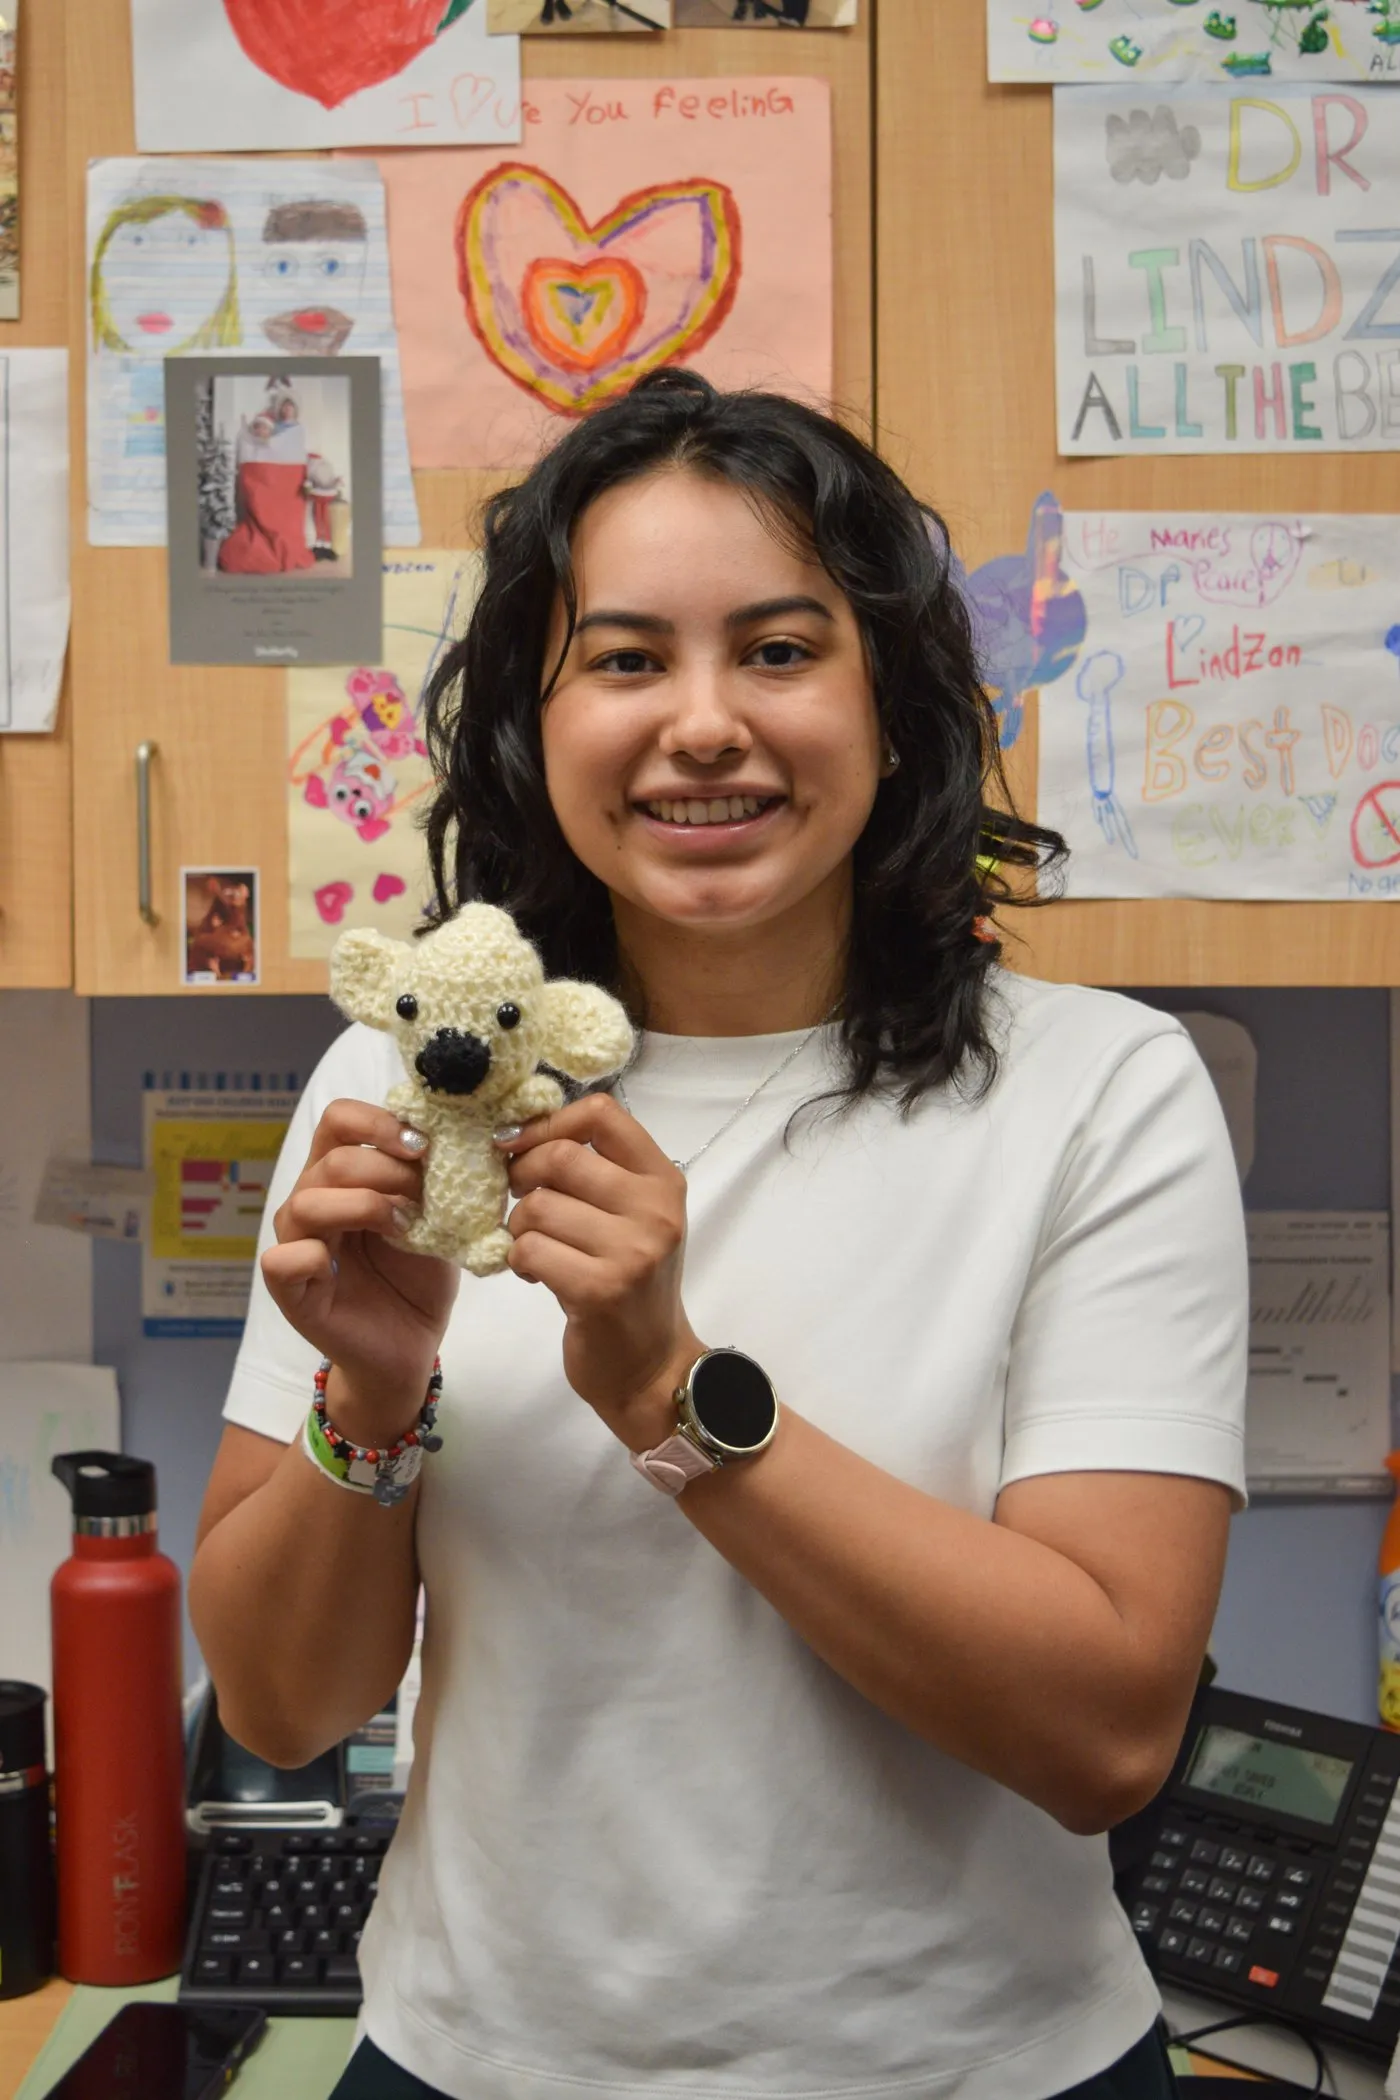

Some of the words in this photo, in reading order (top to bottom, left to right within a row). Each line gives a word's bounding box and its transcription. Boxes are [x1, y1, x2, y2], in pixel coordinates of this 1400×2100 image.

[565, 91, 629, 125] You
[1226, 93, 1372, 197] DR
[1070, 361, 1204, 441] ALL
[1214, 361, 1323, 441] THE
[1141, 698, 1301, 805] Best
